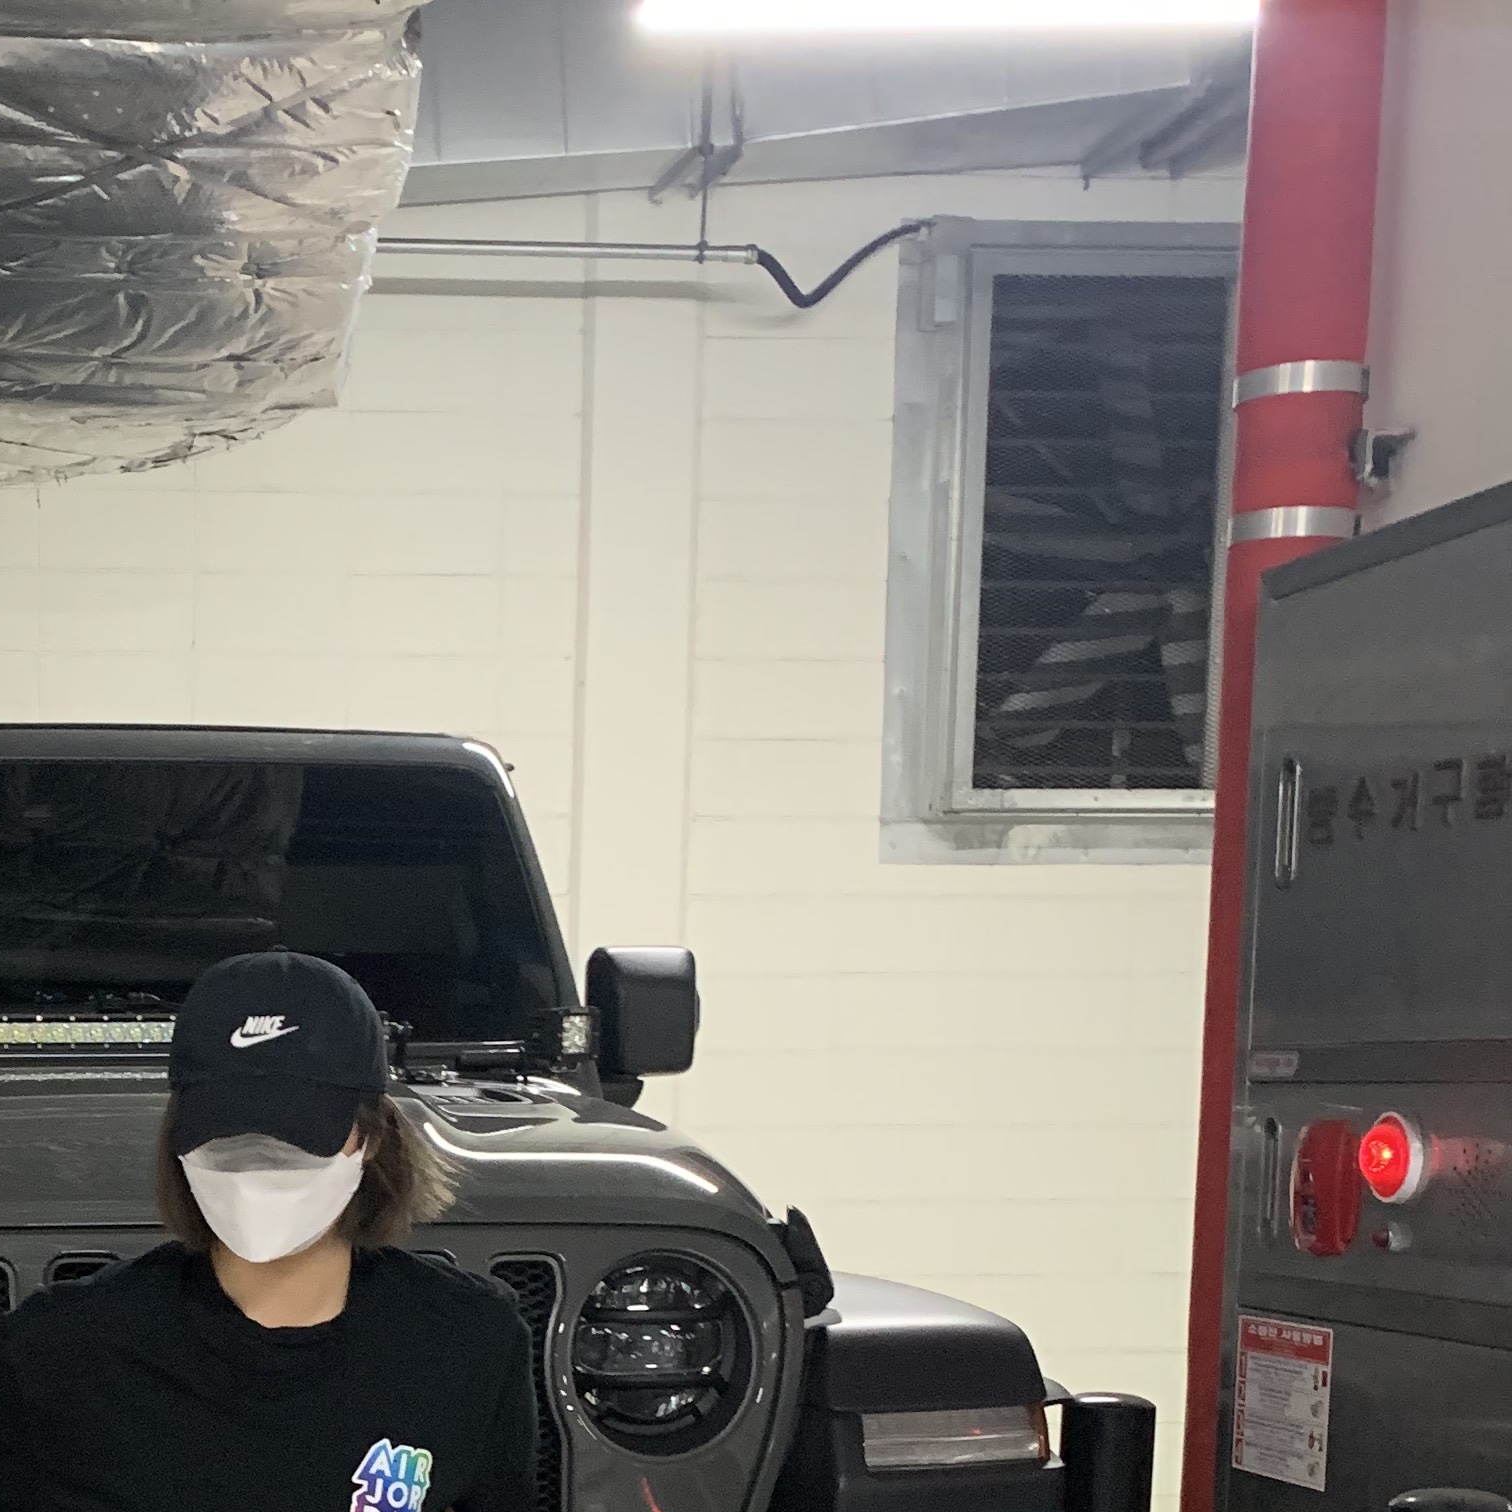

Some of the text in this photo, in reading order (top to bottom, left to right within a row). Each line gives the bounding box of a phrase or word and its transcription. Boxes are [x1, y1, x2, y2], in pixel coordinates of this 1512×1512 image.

[241, 1015, 285, 1035] NIKE
[368, 1449, 428, 1483] AIR
[364, 1478, 422, 1509] JOR
